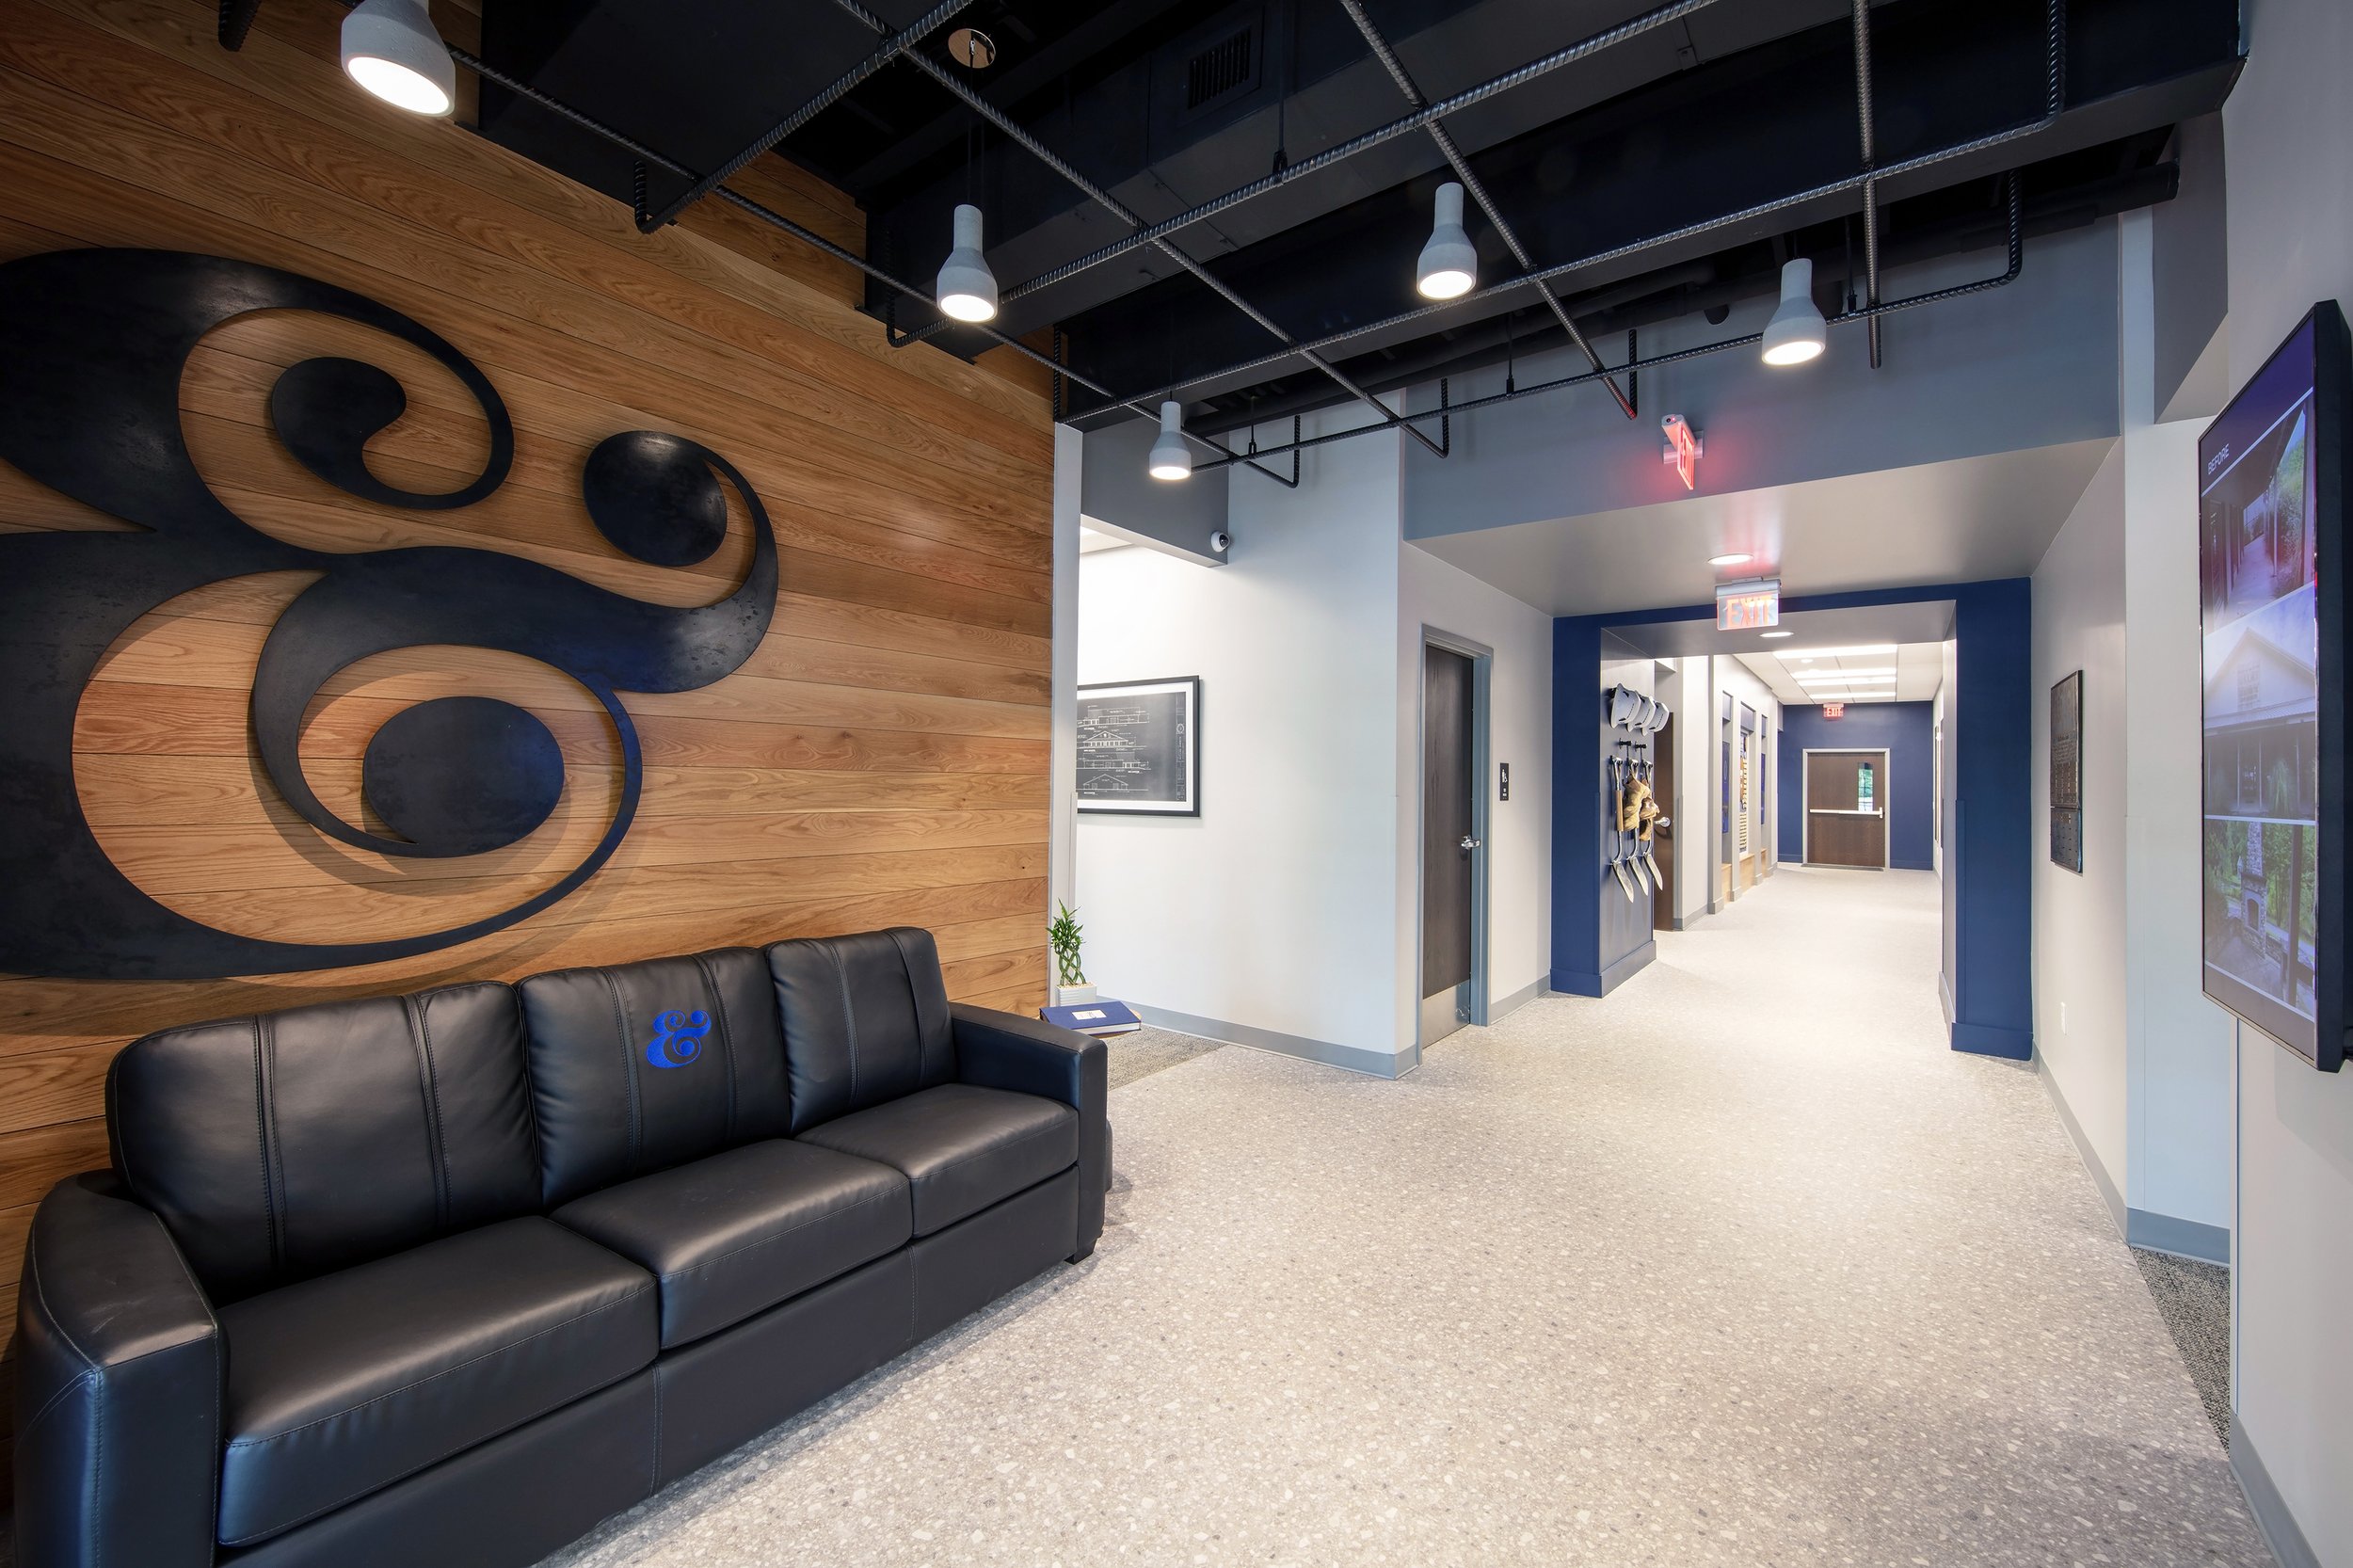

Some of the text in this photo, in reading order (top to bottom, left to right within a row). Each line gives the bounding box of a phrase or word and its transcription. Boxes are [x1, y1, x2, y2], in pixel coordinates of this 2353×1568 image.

[2207, 442, 2230, 475] BEFORE
[1726, 594, 1773, 628] EXIT
[1826, 707, 1841, 717] EXIT
[646, 1010, 712, 1068] &
